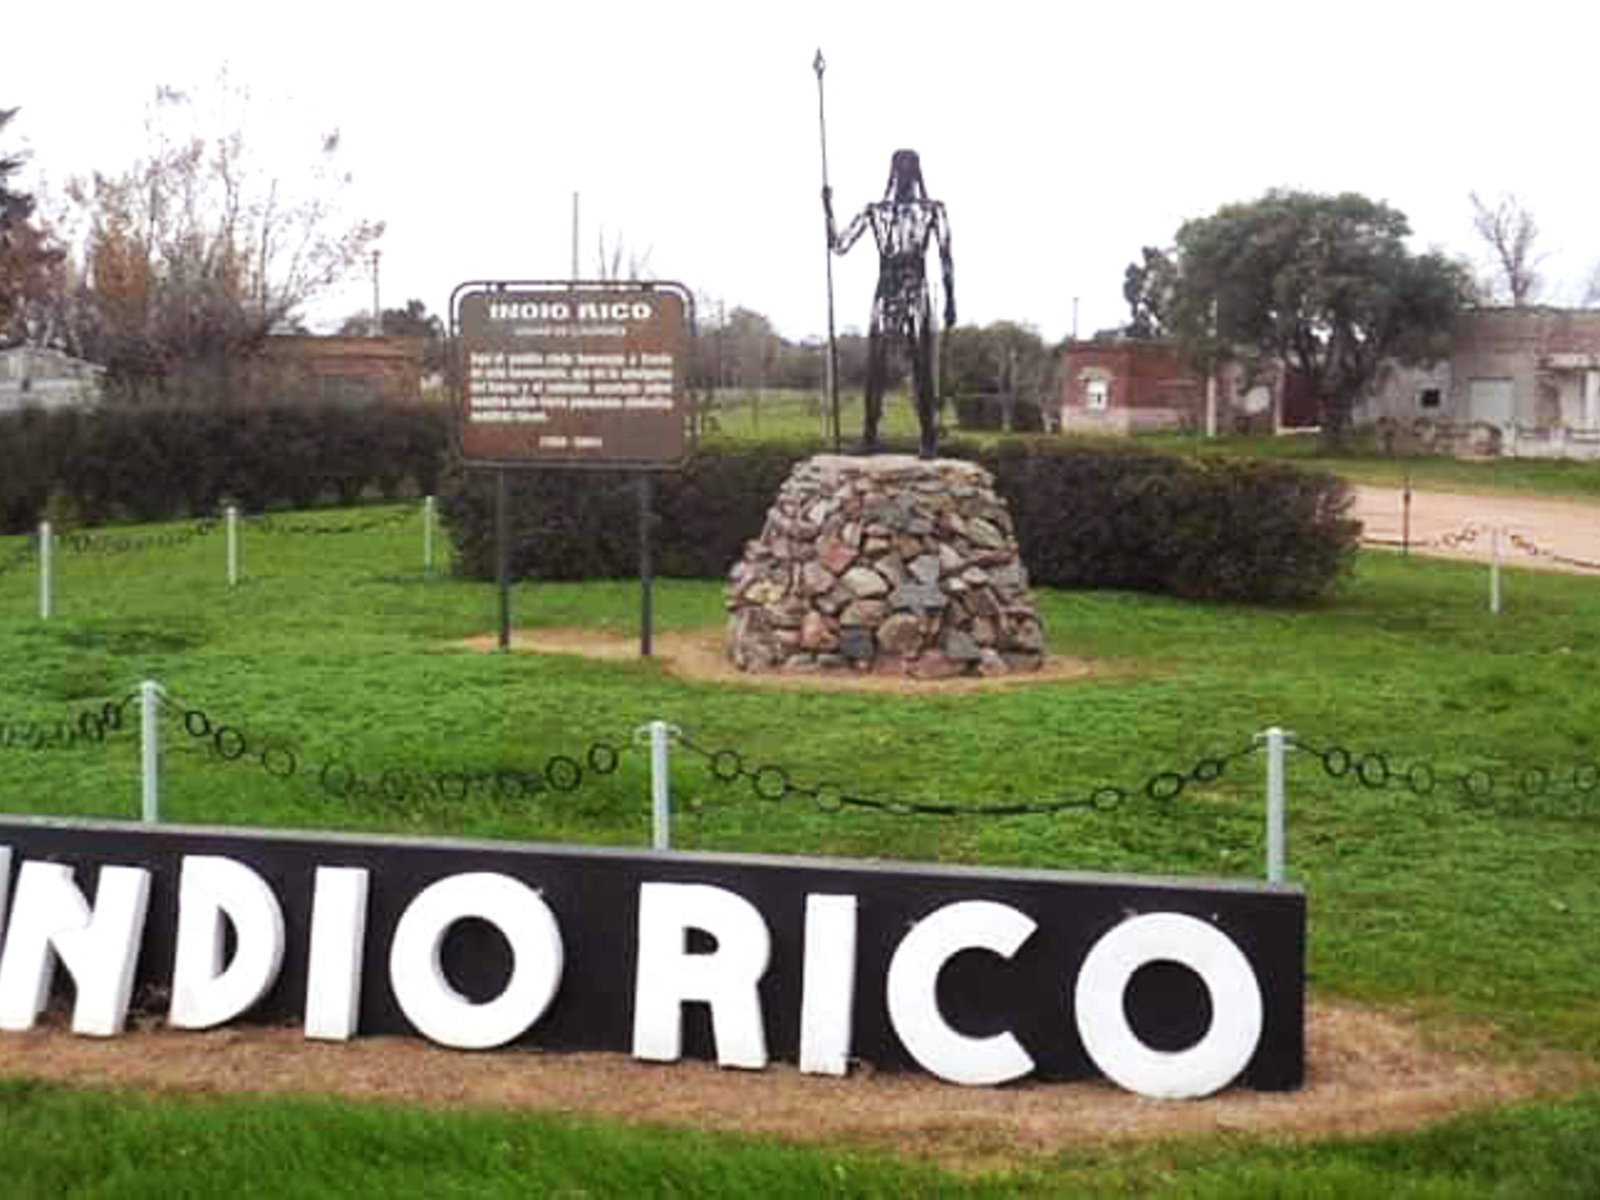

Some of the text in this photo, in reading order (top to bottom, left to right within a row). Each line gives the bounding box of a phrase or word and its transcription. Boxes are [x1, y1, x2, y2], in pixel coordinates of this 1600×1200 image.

[489, 302, 652, 320] INDIO RICO
[0, 846, 1264, 1099] NDIO RICO
